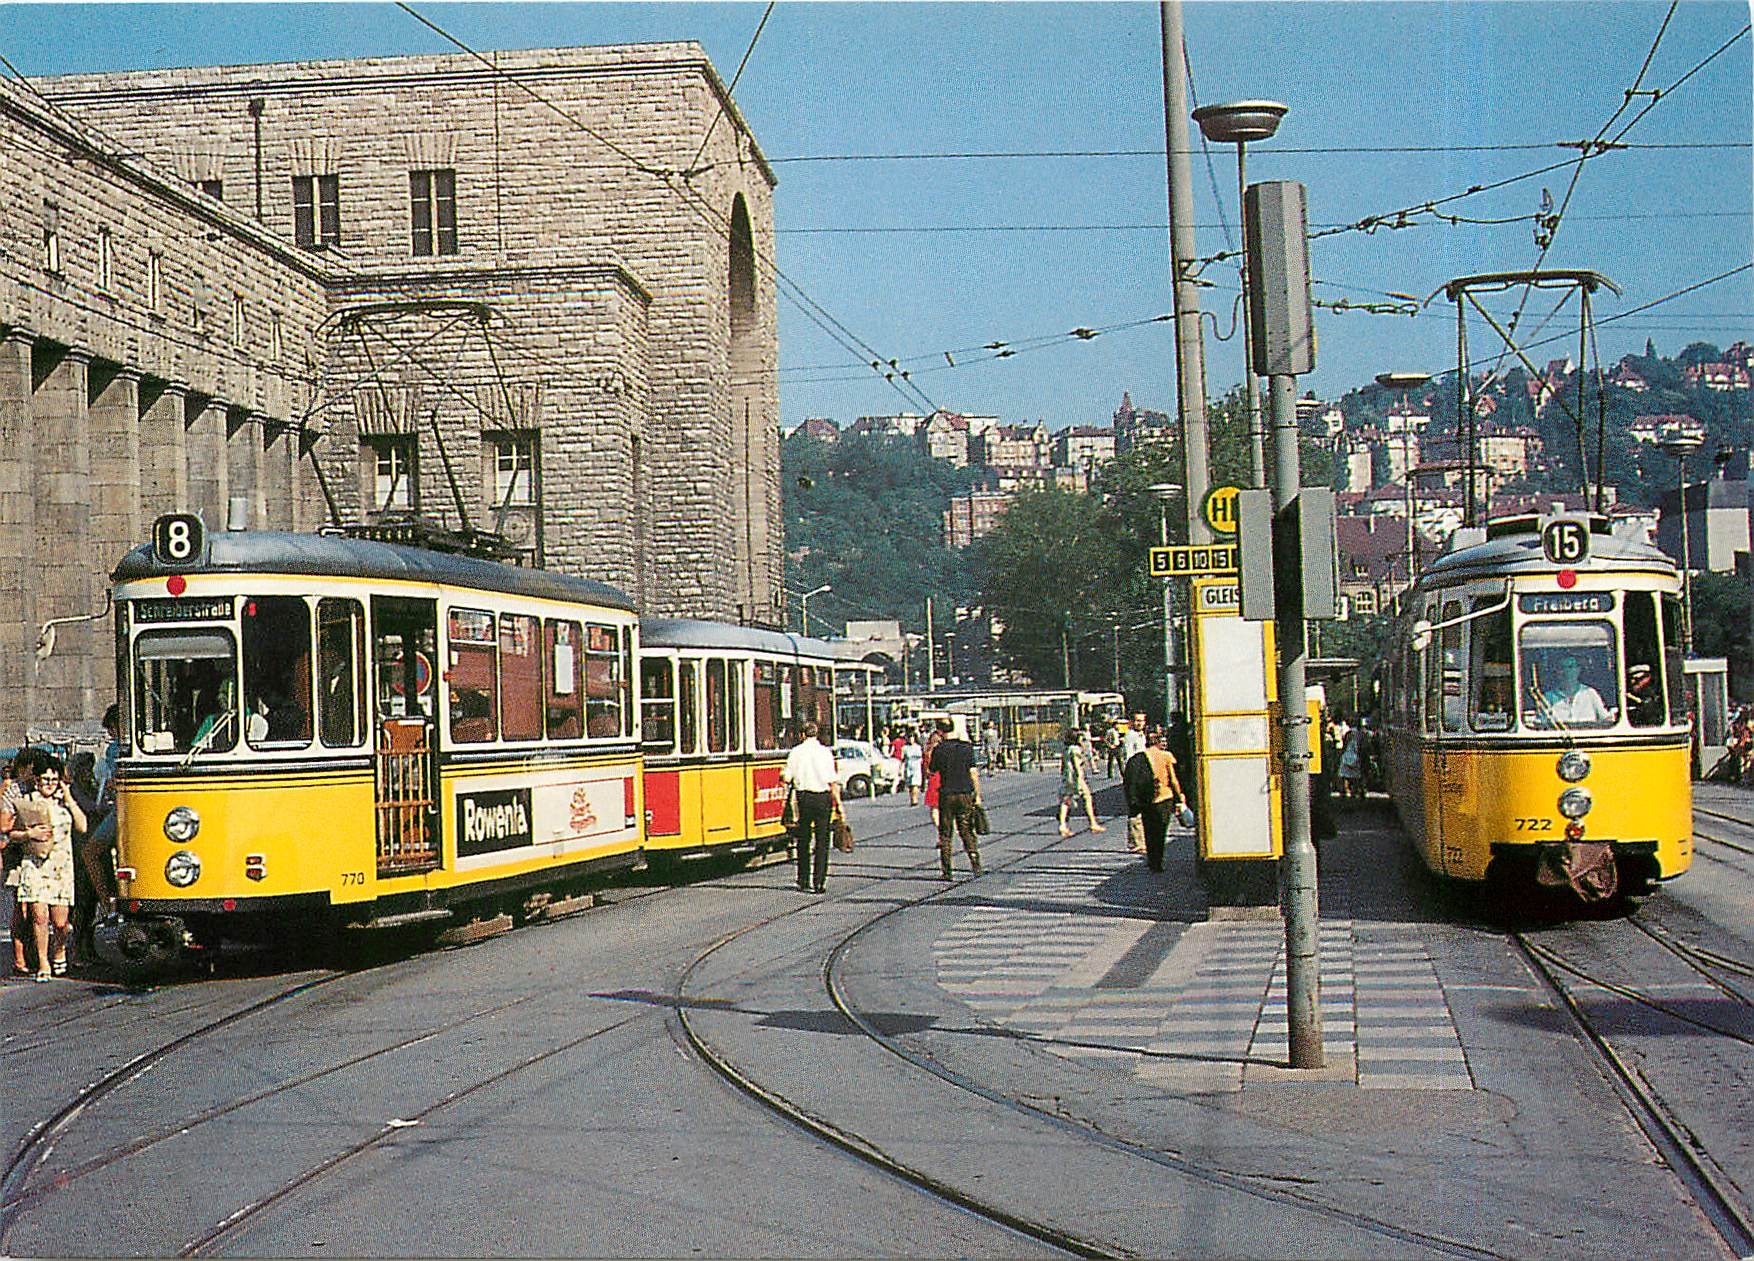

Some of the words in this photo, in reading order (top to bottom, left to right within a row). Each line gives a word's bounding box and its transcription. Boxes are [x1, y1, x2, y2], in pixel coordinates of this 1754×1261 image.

[169, 521, 191, 558] 8
[1551, 525, 1580, 560] 15
[1156, 553, 1167, 569] 5
[1177, 552, 1186, 568] 6
[1194, 551, 1208, 567] 10
[1213, 551, 1227, 567] 15
[463, 795, 529, 842] Rowenta
[1515, 818, 1553, 831] 722
[341, 872, 365, 887] 770
